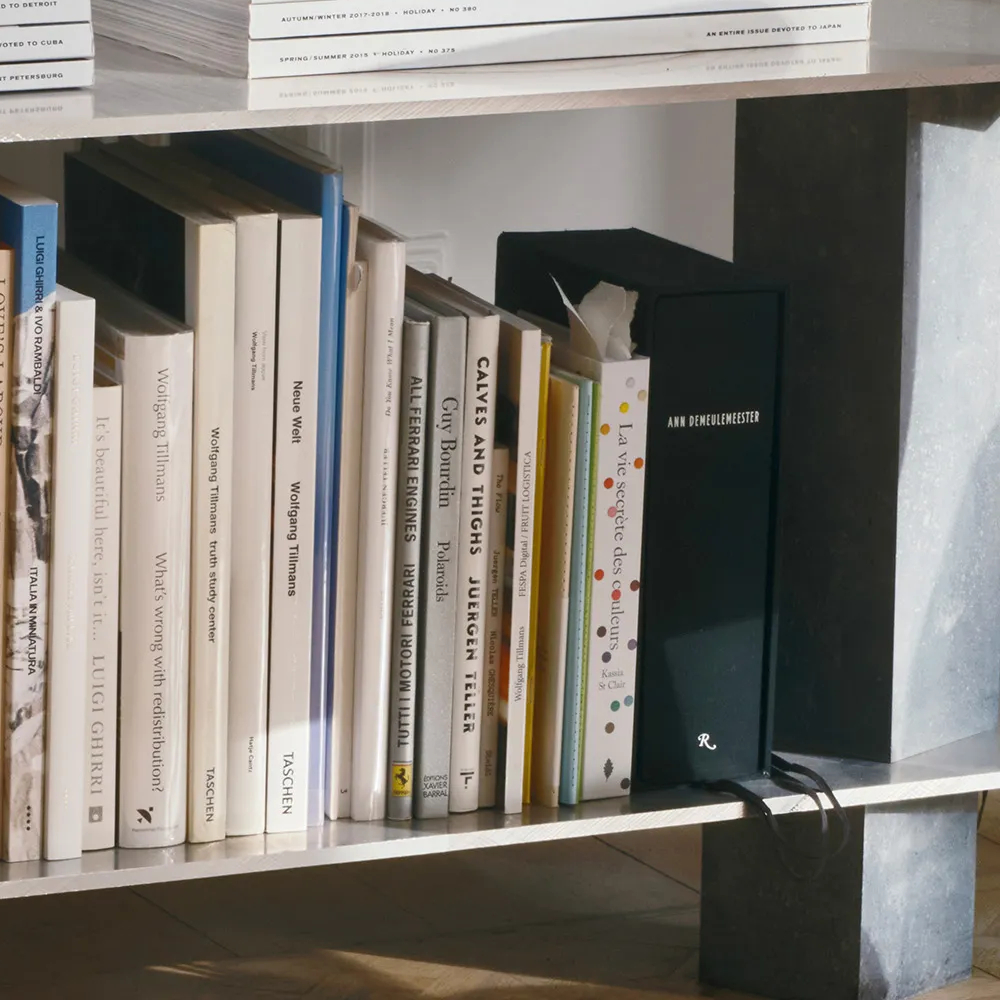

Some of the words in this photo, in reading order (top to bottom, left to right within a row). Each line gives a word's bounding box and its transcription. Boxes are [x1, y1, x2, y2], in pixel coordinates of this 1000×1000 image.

[9, 72, 64, 81] PETERSBURG
[35, 235, 45, 265] LUIGI
[34, 266, 45, 304] GHIRRI
[34, 305, 44, 314] &
[33, 315, 44, 335] IVO
[32, 337, 44, 396] RAMBALDI
[410, 375, 423, 404] ALL
[474, 356, 490, 426] CALVES
[152, 367, 170, 439] Wolfgang
[292, 380, 304, 413] Neue
[436, 396, 459, 434] Guy
[667, 415, 686, 428] ANN
[688, 410, 760, 428] DEMEULEMEESTER
[207, 426, 220, 483] Wolfgang
[291, 415, 303, 444] Welt
[406, 407, 422, 471] FERRARI
[472, 433, 486, 476] AND
[618, 423, 633, 446] La
[94, 447, 111, 521] beautiful
[156, 440, 169, 502] Tillmans
[438, 437, 457, 509] Bourdin
[616, 452, 631, 477] vie
[209, 484, 220, 535] Tillmans
[286, 481, 301, 541] Wolfgang
[404, 475, 418, 542] ENGINES
[469, 484, 485, 556] THIGHS
[614, 481, 628, 541] secrète
[91, 526, 109, 566] here,
[209, 540, 218, 569] truth
[287, 543, 300, 597] Tillmans
[436, 541, 450, 603] Polaroids
[612, 546, 627, 575] des
[28, 566, 38, 601] ITALIA
[28, 603, 38, 614] IN
[206, 571, 218, 604] study
[402, 563, 416, 626] FERRARI
[149, 605, 164, 653] wrong
[207, 605, 217, 644] center
[465, 576, 480, 661] JUERGEN
[27, 615, 37, 676] MINIATURA
[152, 655, 167, 687] with
[399, 634, 413, 692] MOTORI
[91, 655, 105, 713] LUIGI
[462, 671, 477, 734] TELLER
[151, 692, 166, 793] redistribution?
[398, 704, 410, 748] TUTTI
[90, 720, 104, 795] GHIRRI
[281, 751, 295, 815] TASCHEN
[205, 766, 216, 823] TASCHEN
